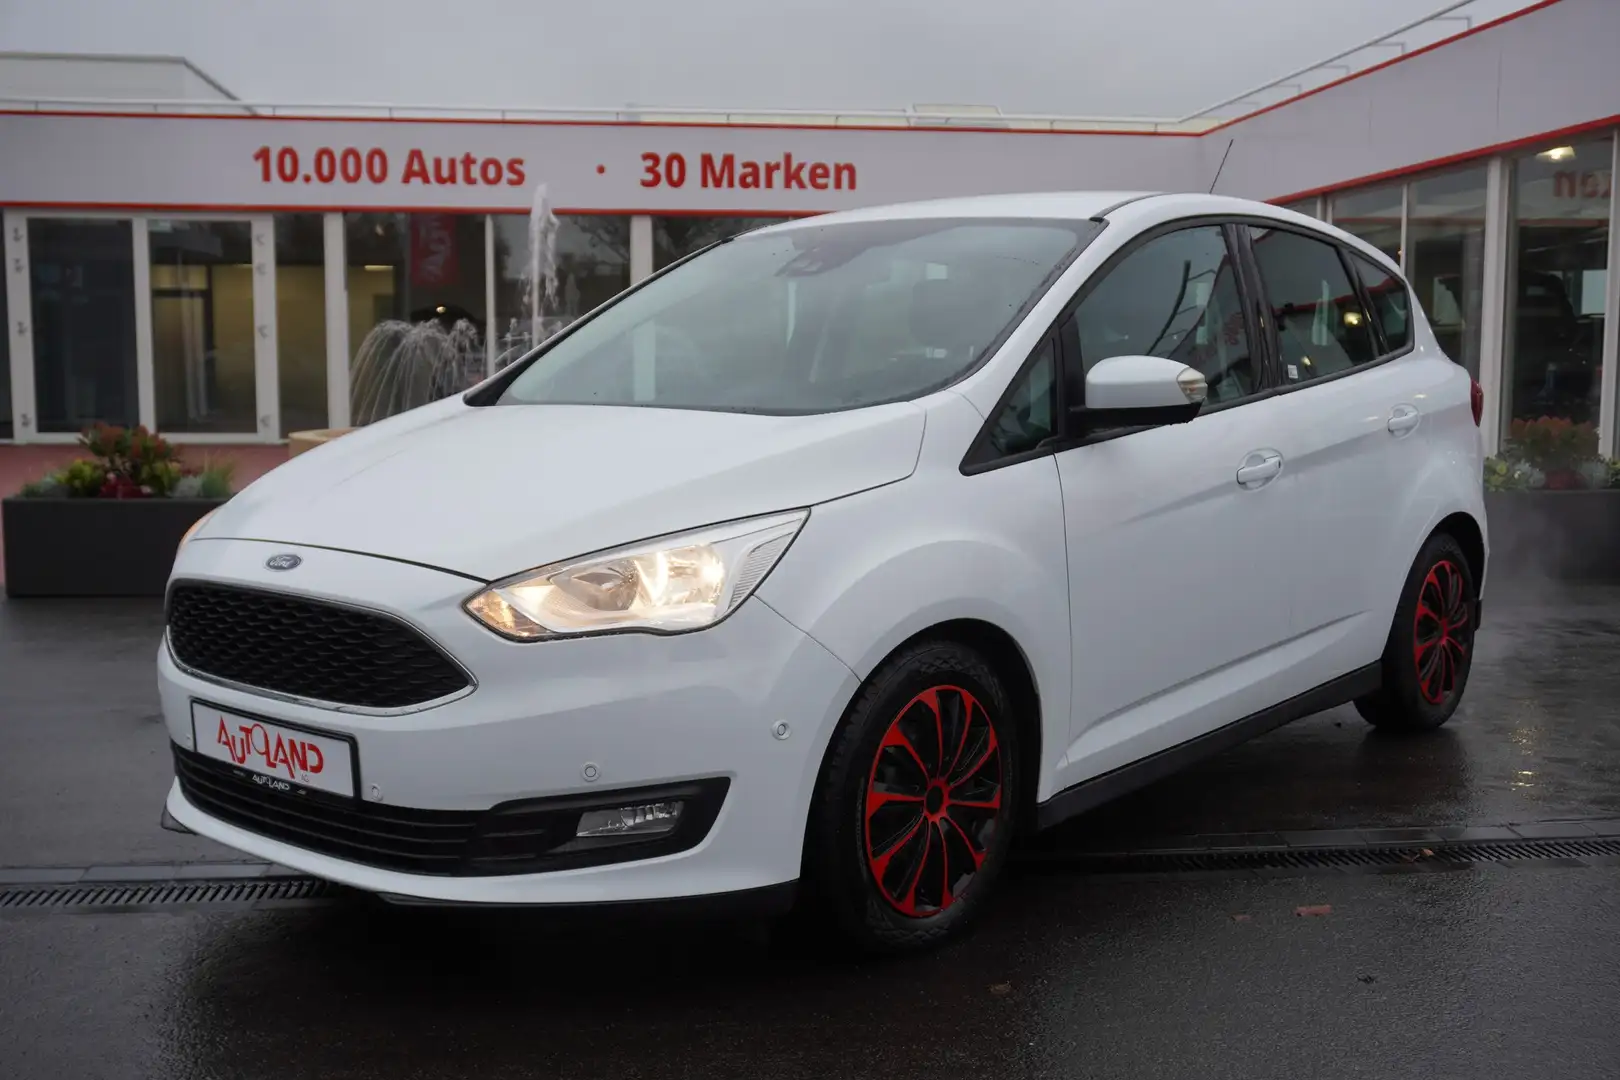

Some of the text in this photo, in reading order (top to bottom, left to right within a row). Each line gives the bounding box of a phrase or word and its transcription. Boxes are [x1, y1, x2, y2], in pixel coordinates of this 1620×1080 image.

[253, 146, 858, 192] 10.000 Autos 30 Marken
[269, 555, 295, 568] Ford
